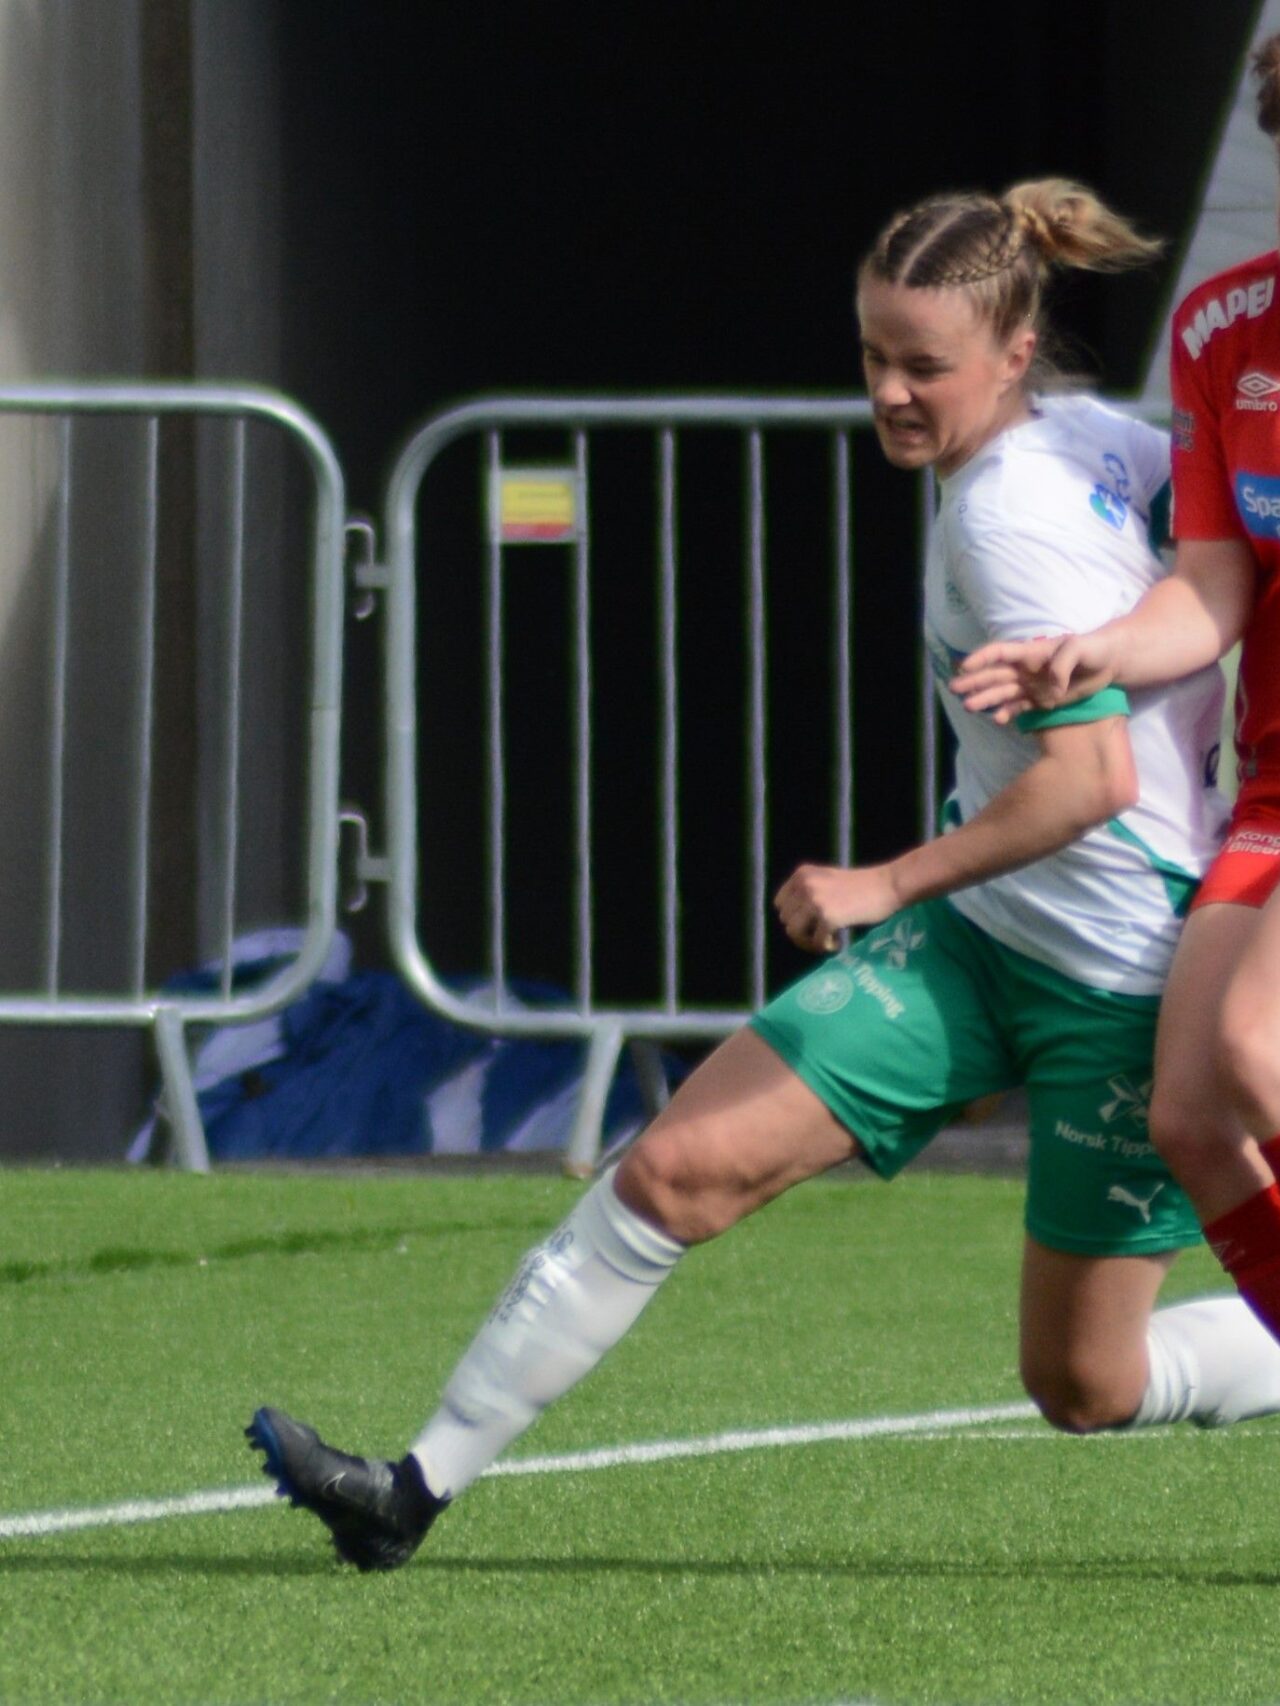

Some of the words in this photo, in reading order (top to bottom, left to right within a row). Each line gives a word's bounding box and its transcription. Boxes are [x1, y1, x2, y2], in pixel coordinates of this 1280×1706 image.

[1181, 275, 1276, 362] MAPEI
[1235, 398, 1279, 413] umbro
[1111, 1135, 1155, 1159] Tipp
